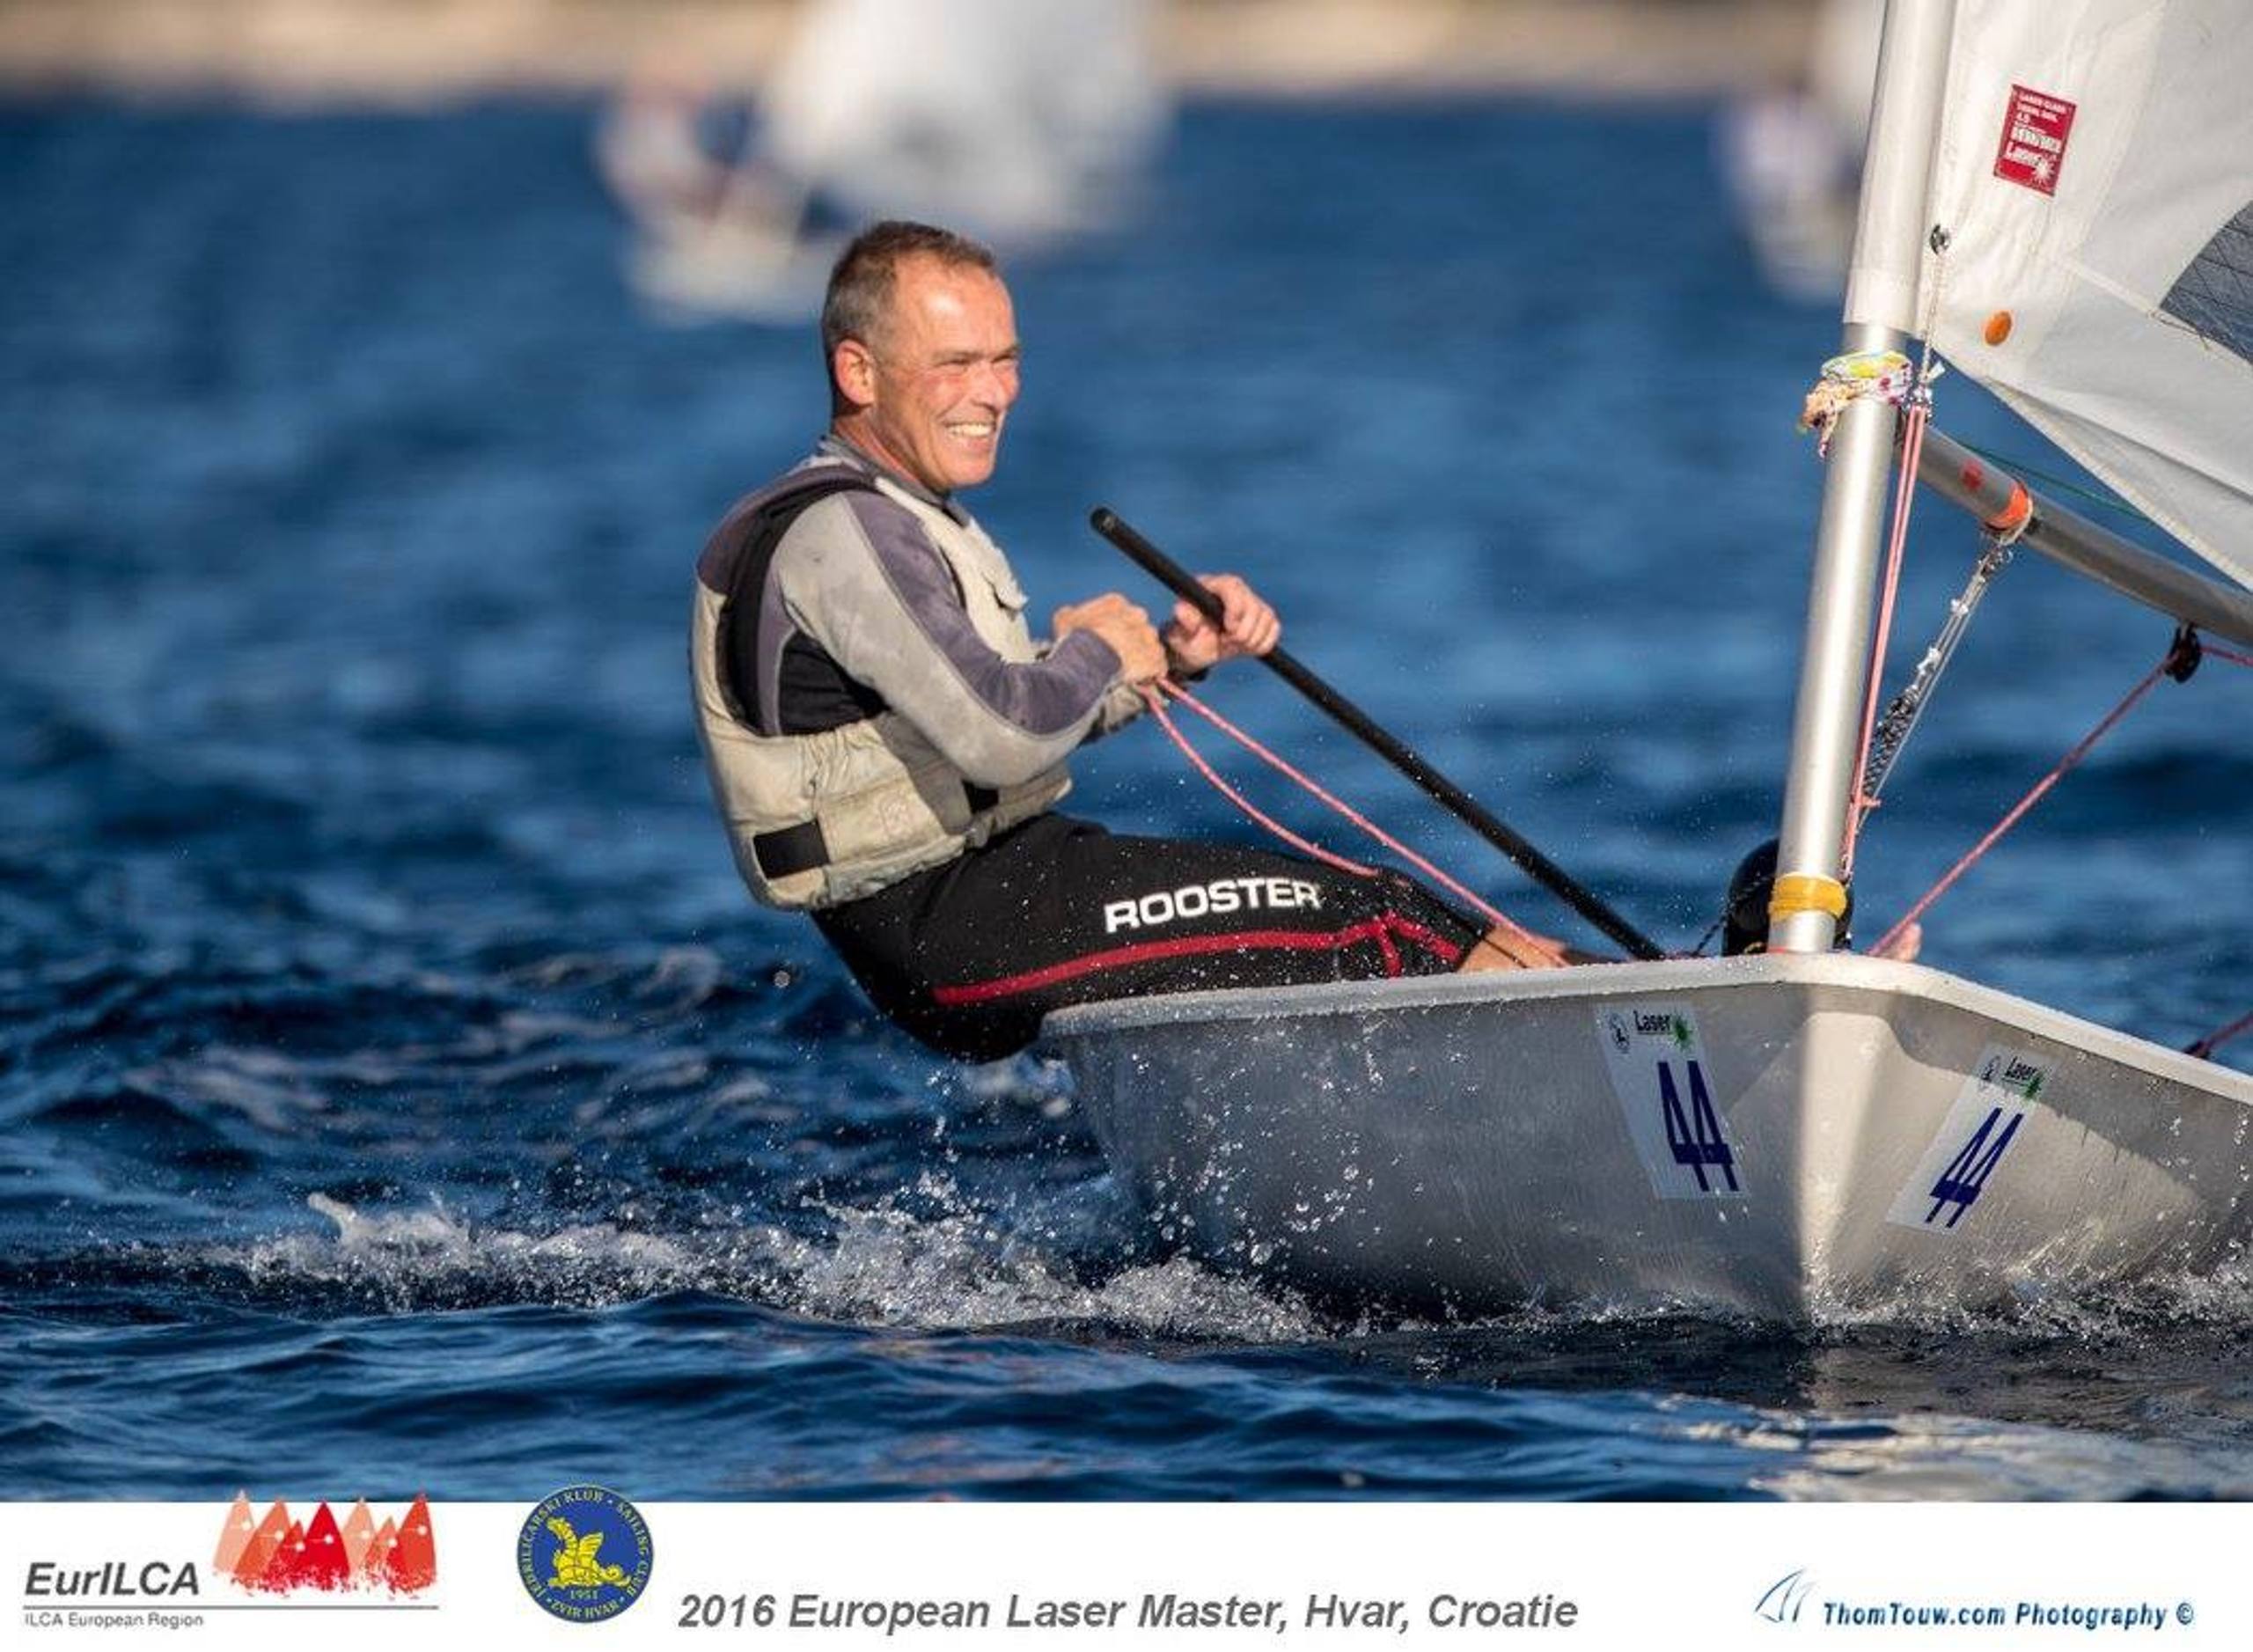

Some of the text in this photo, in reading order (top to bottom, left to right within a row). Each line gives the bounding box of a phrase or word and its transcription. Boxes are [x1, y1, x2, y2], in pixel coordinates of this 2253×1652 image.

[1104, 878, 1320, 933] ROOSTER
[1633, 1010, 1671, 1032] Laser
[2005, 1056, 2038, 1081] Laser
[1659, 1061, 1739, 1192] 44
[1925, 1107, 2024, 1229] 44
